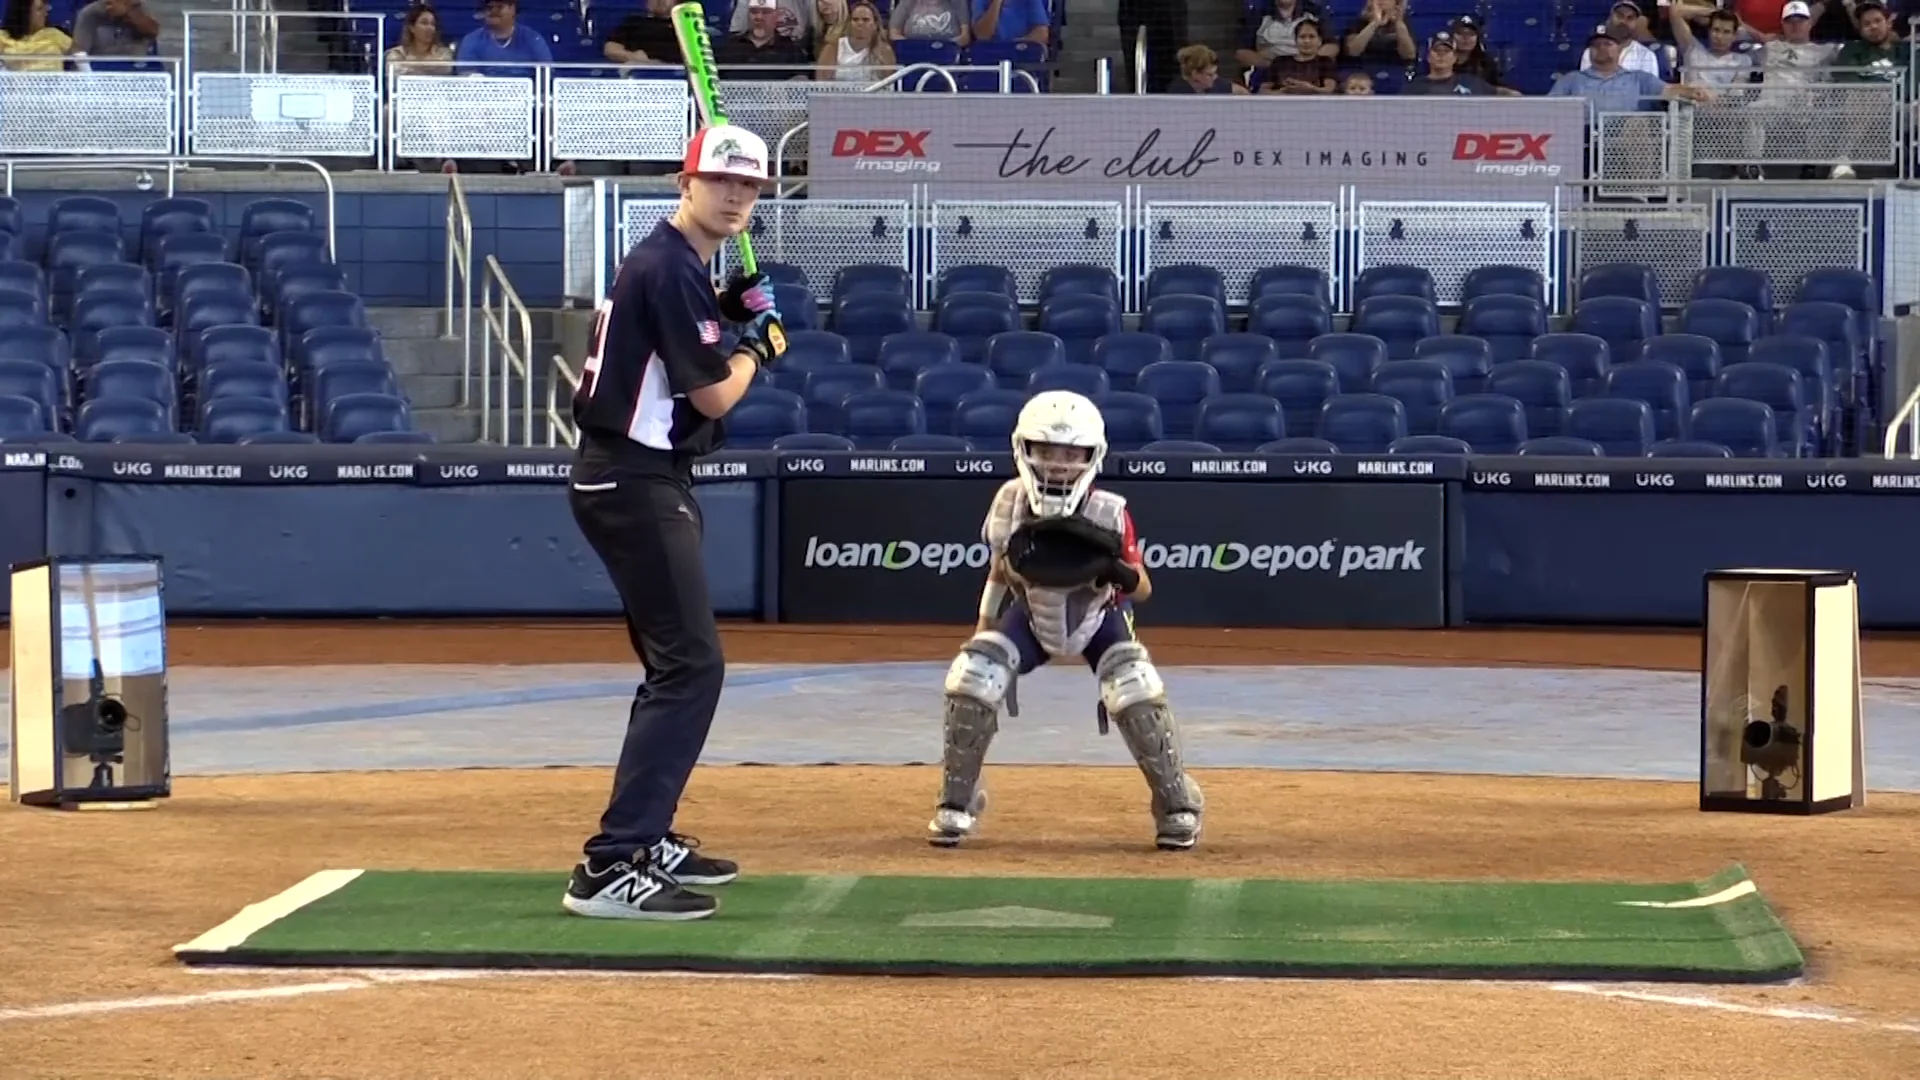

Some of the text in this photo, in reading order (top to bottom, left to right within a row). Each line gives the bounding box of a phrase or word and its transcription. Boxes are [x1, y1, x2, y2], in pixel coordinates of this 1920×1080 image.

[831, 130, 932, 157] DEX
[1452, 133, 1553, 161] DEX
[953, 128, 1219, 178] the club
[1233, 151, 1429, 167] DEX IMAGING
[854, 158, 941, 173] imaging
[1475, 161, 1562, 177] imaging
[113, 461, 152, 476] UKG
[164, 464, 242, 479] MARLINS.COM
[269, 465, 308, 479] UKG
[440, 464, 479, 479] UKG
[786, 457, 824, 472] UKG
[850, 458, 925, 472] MARLINS.COM
[955, 459, 993, 473] UKG
[1128, 460, 1166, 475] UKG
[1192, 460, 1267, 475] MARLINS.COM
[1293, 460, 1332, 475] UKG
[1357, 460, 1434, 475] MARLINS.COM
[1473, 472, 1511, 485] UKG
[1534, 473, 1610, 488] MARLINS.COM
[1635, 473, 1675, 487] UKG
[1706, 473, 1783, 488] MARLINS.COM
[1872, 475, 1920, 488] MARLINS
[804, 535, 991, 575] loanDepo
[1338, 538, 1426, 579] park
